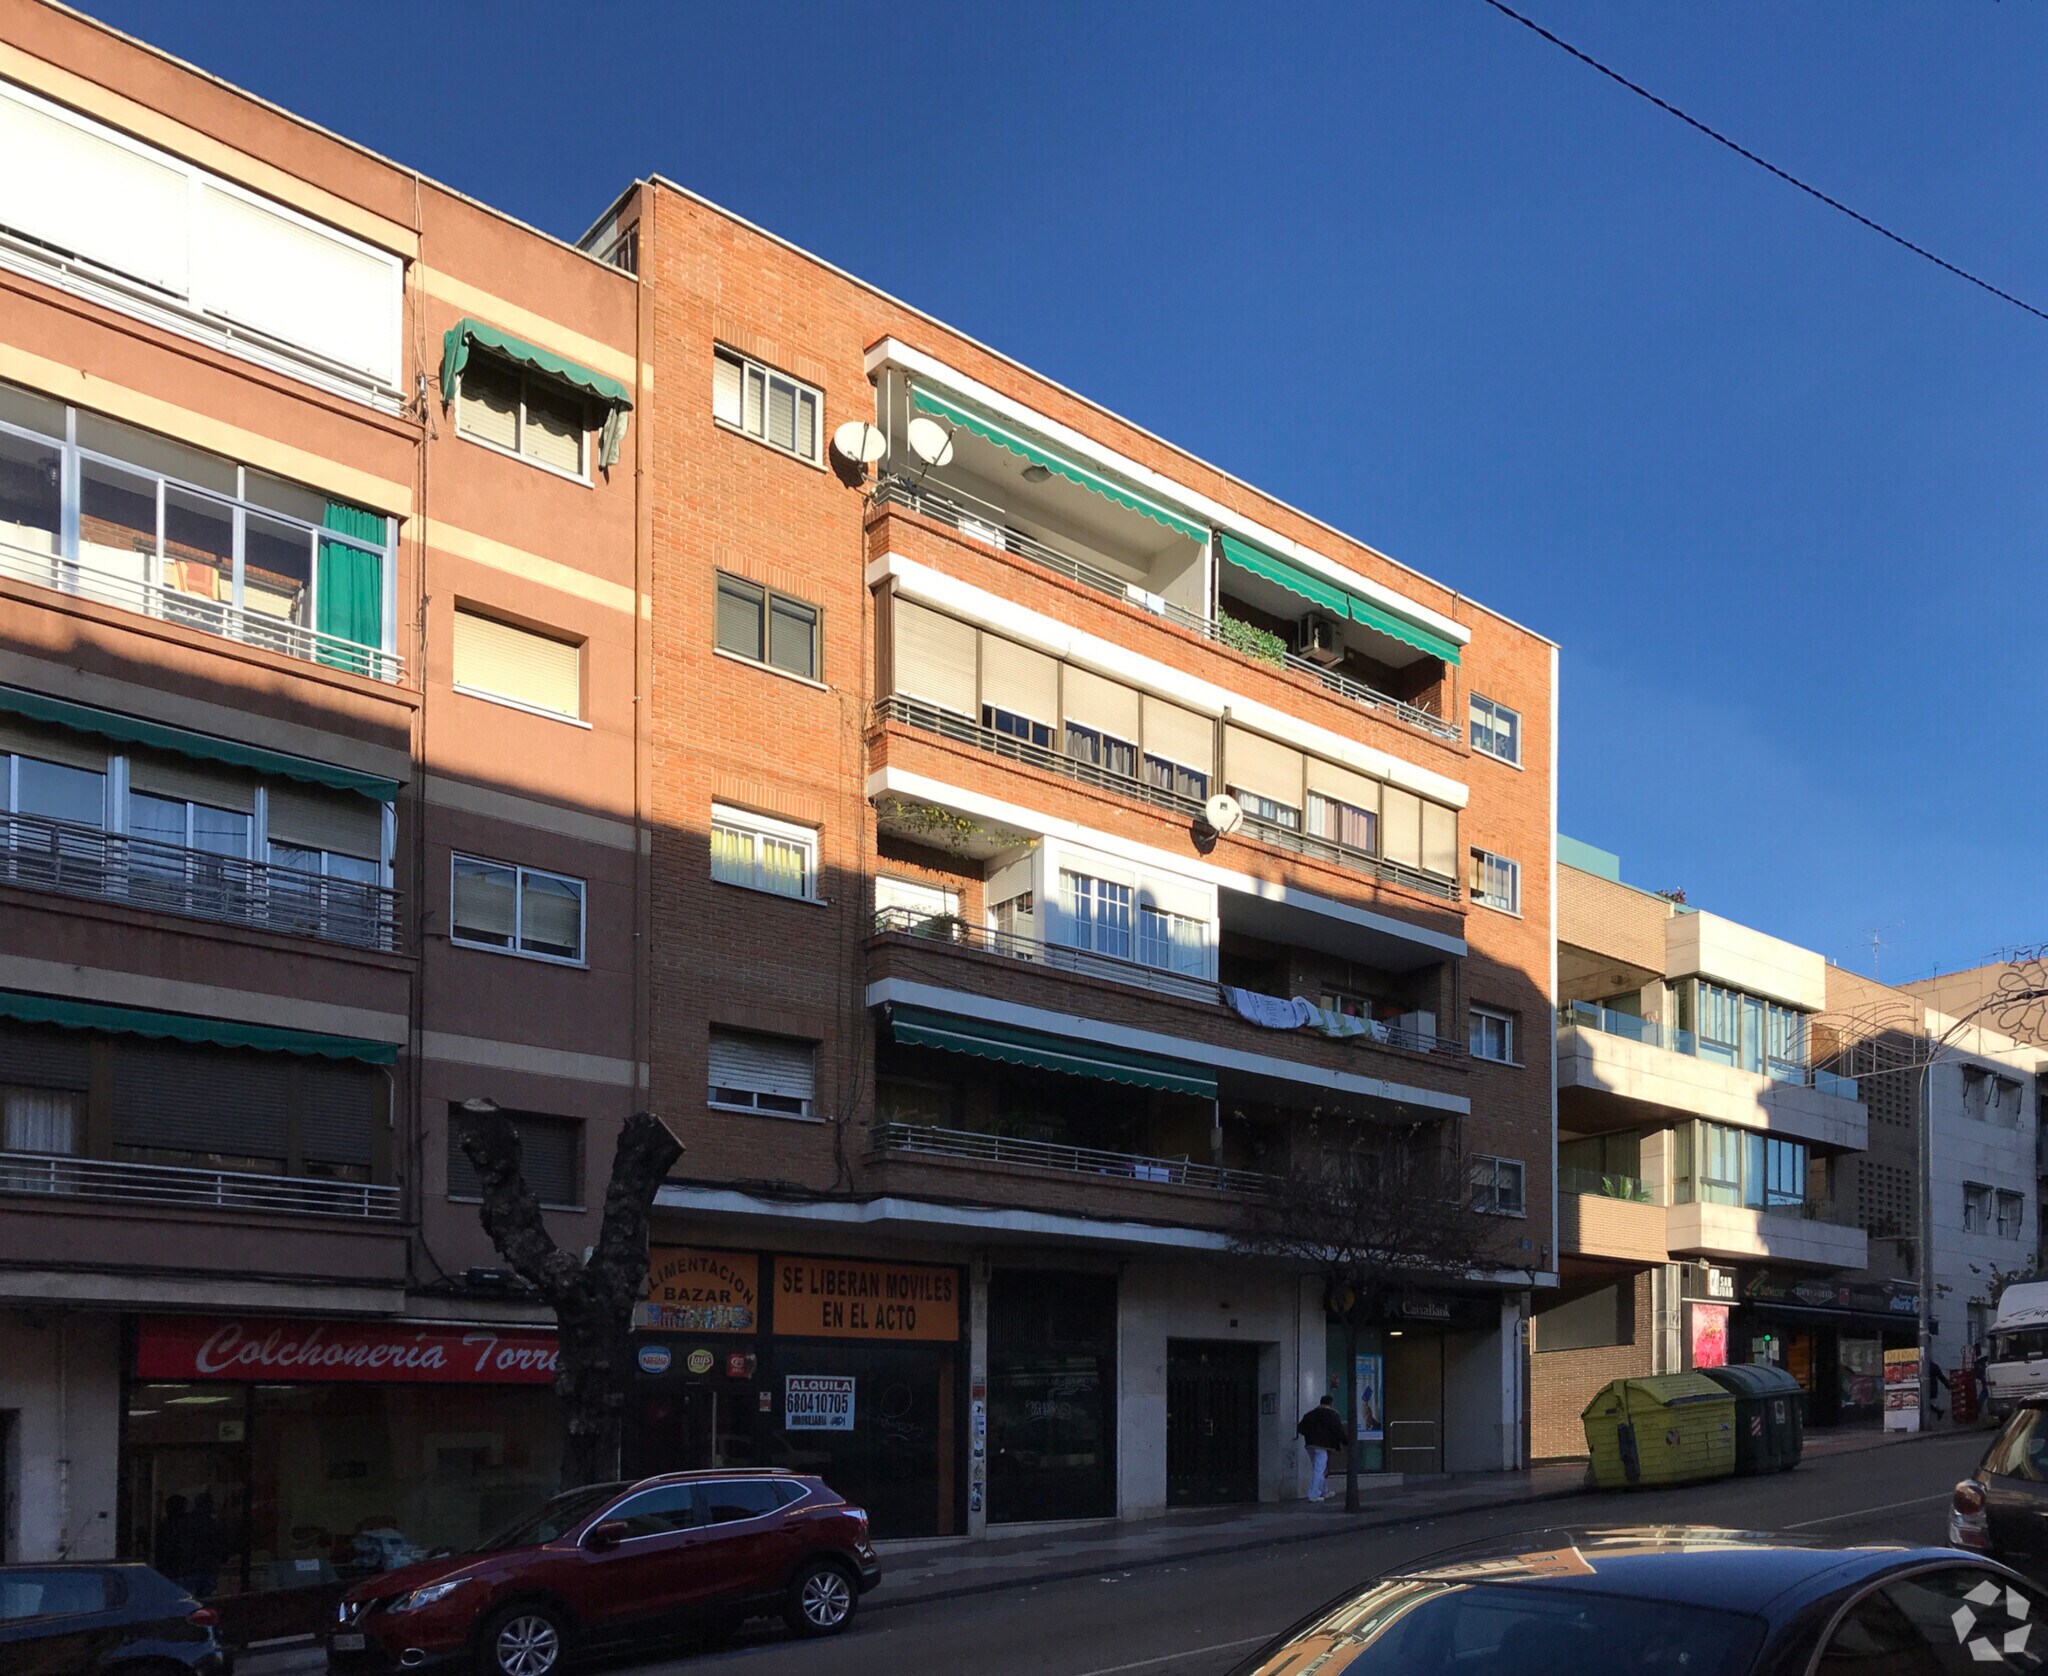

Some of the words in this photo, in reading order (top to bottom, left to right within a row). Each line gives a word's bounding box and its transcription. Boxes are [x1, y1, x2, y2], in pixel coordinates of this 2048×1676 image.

[783, 1266, 803, 1293] SE
[810, 1267, 880, 1298] LIBERAN
[886, 1273, 952, 1302] MOVILES
[1719, 1275, 1732, 1288] SAN
[664, 1286, 731, 1303] BAZAR
[822, 1301, 843, 1328] EN
[850, 1302, 869, 1329] EL
[875, 1304, 916, 1331] ACTO
[195, 1322, 447, 1374] Colchonería
[790, 1380, 852, 1392] ALQUILA
[787, 1393, 849, 1414] 680410705
